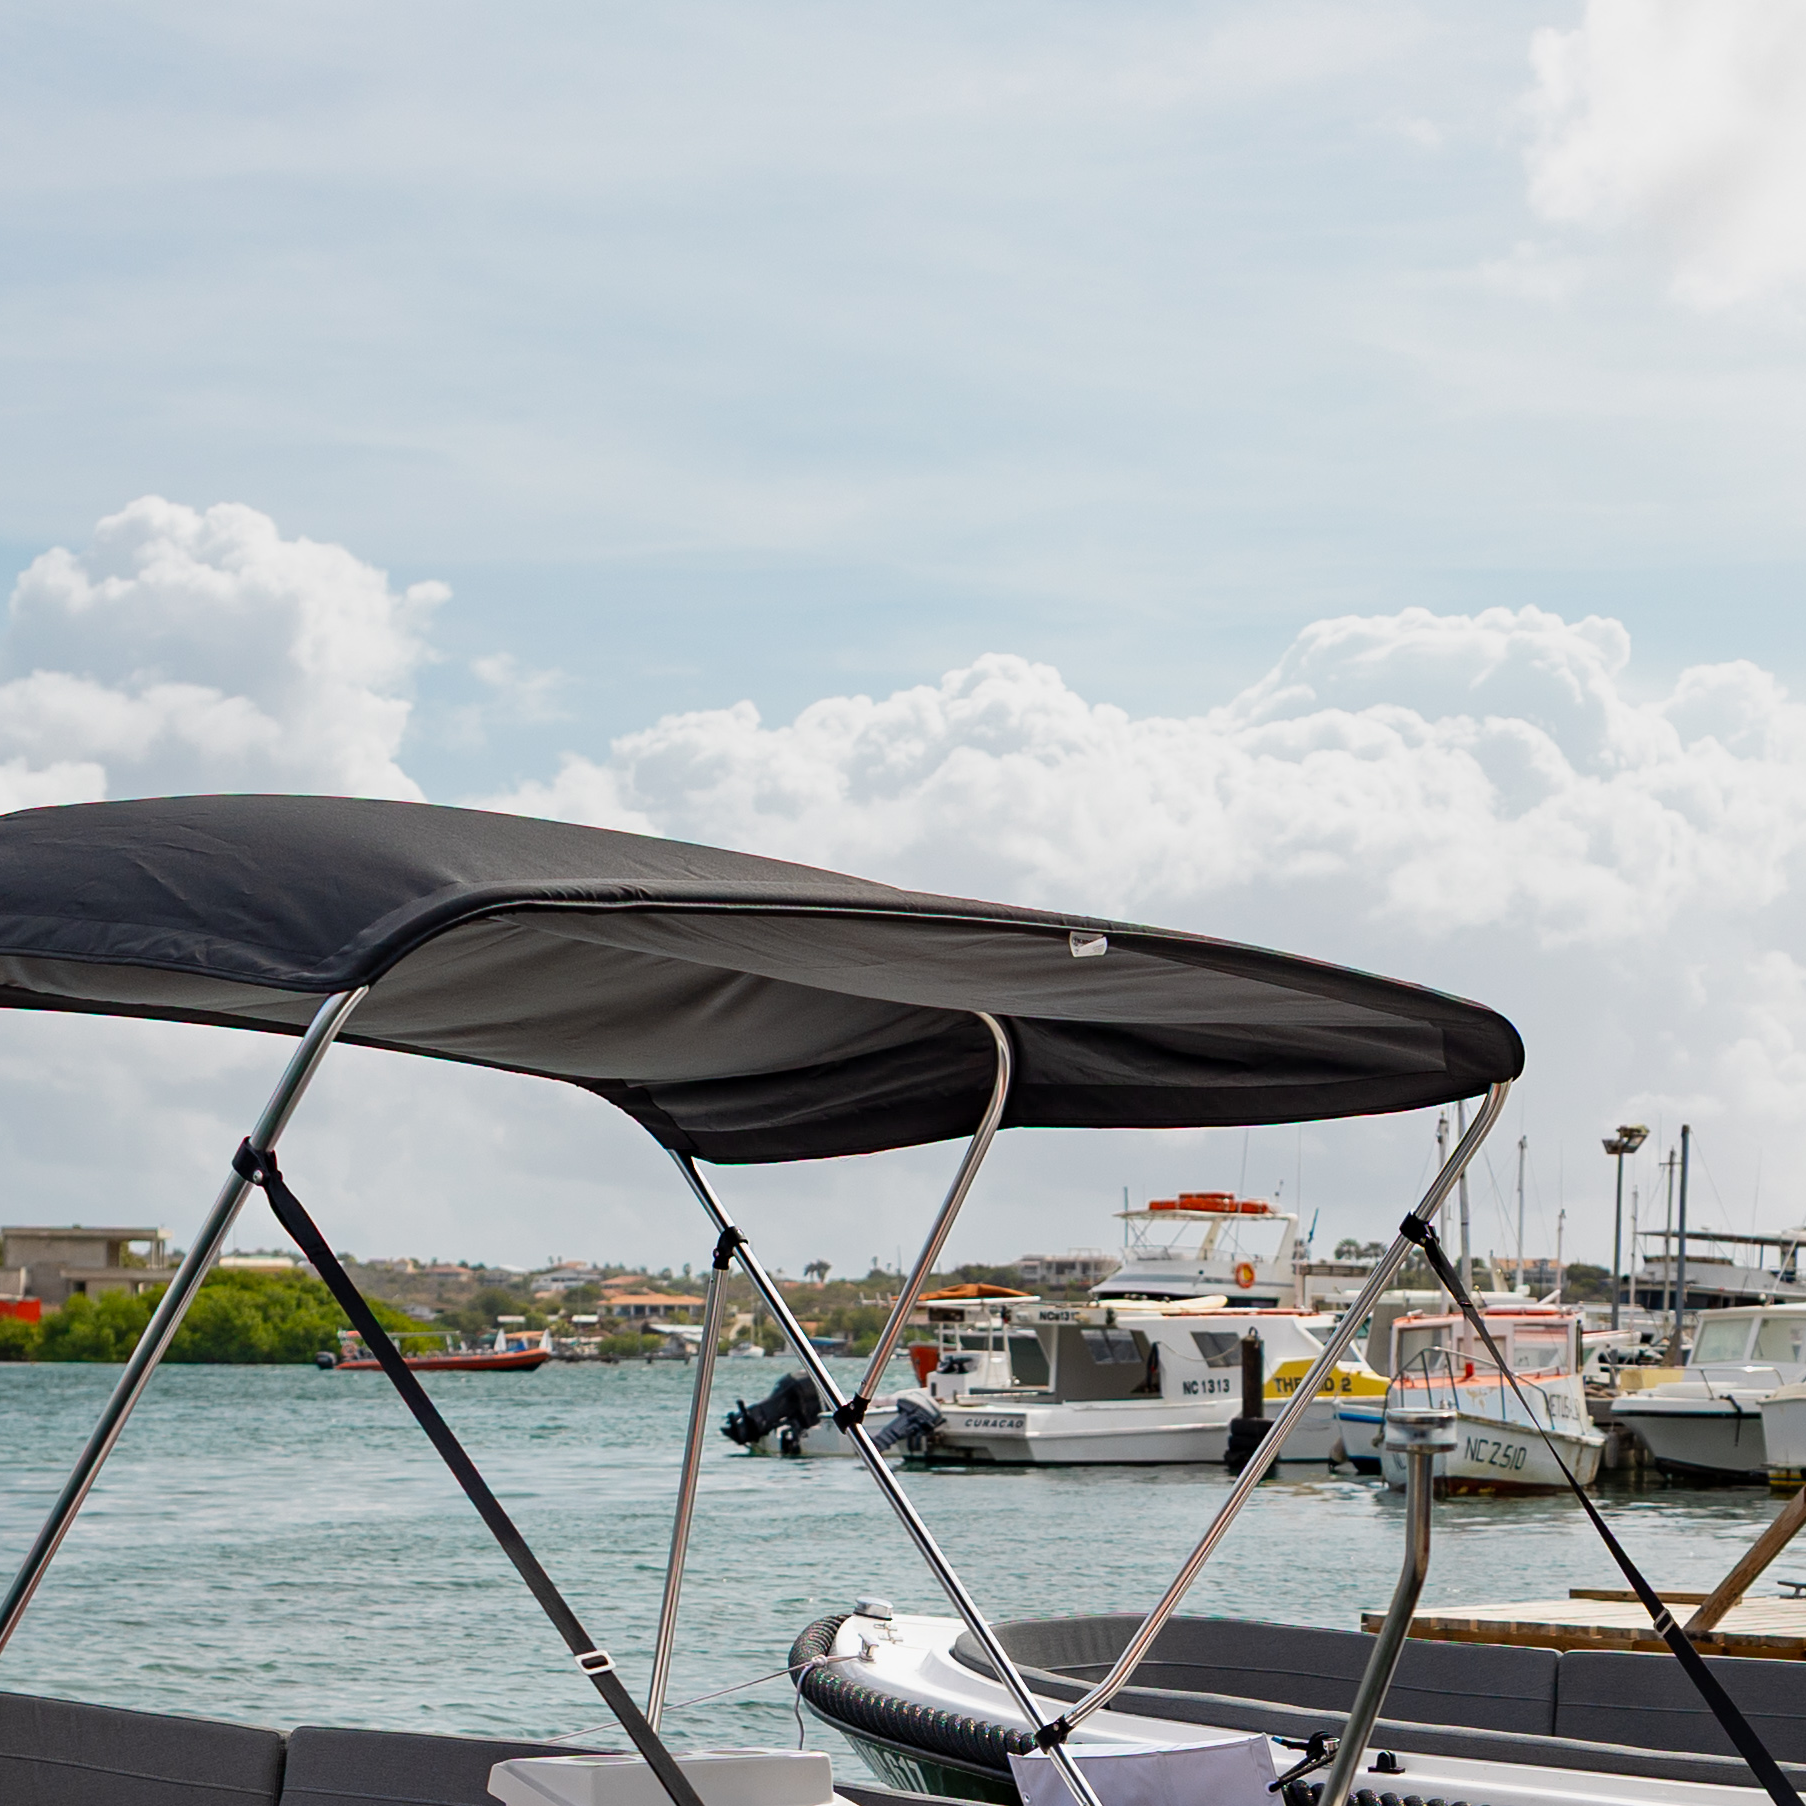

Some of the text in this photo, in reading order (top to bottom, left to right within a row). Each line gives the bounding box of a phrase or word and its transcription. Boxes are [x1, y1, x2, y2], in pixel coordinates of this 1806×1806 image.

[1183, 1379, 1230, 1394] NC 1313
[1464, 1436, 1489, 1462] NC
